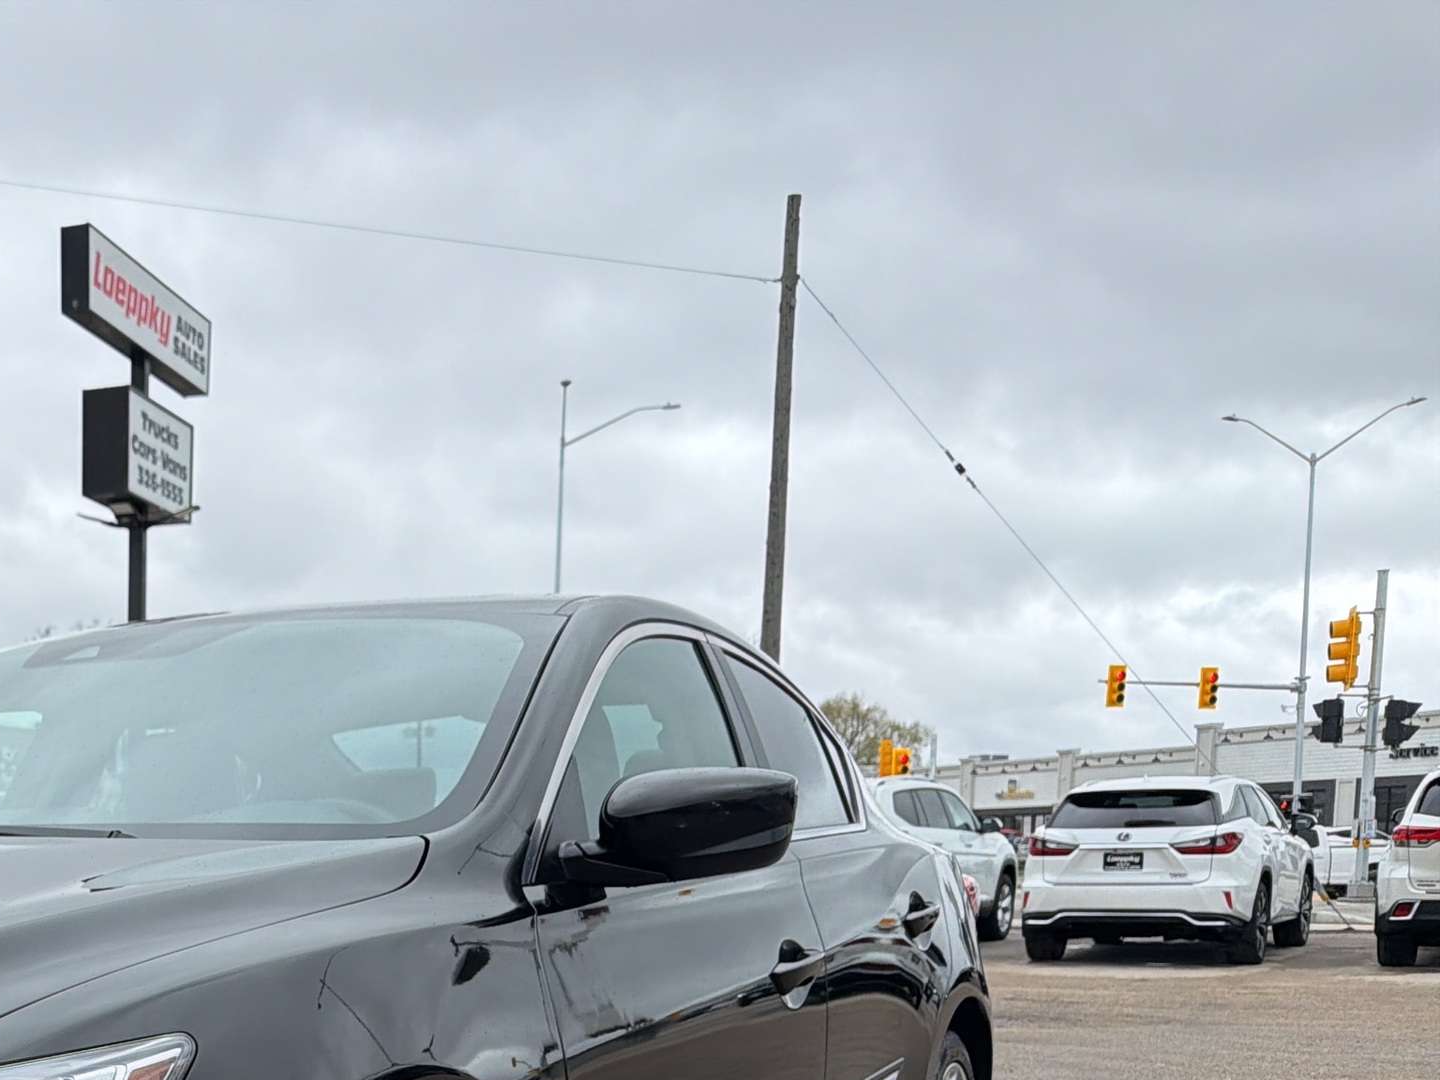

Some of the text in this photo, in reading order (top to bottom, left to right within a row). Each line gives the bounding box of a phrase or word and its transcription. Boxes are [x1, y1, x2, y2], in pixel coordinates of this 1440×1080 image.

[93, 251, 171, 347] Loeppky
[176, 315, 204, 351] AUTO
[173, 336, 205, 375] SALES
[140, 410, 178, 450] Trucks
